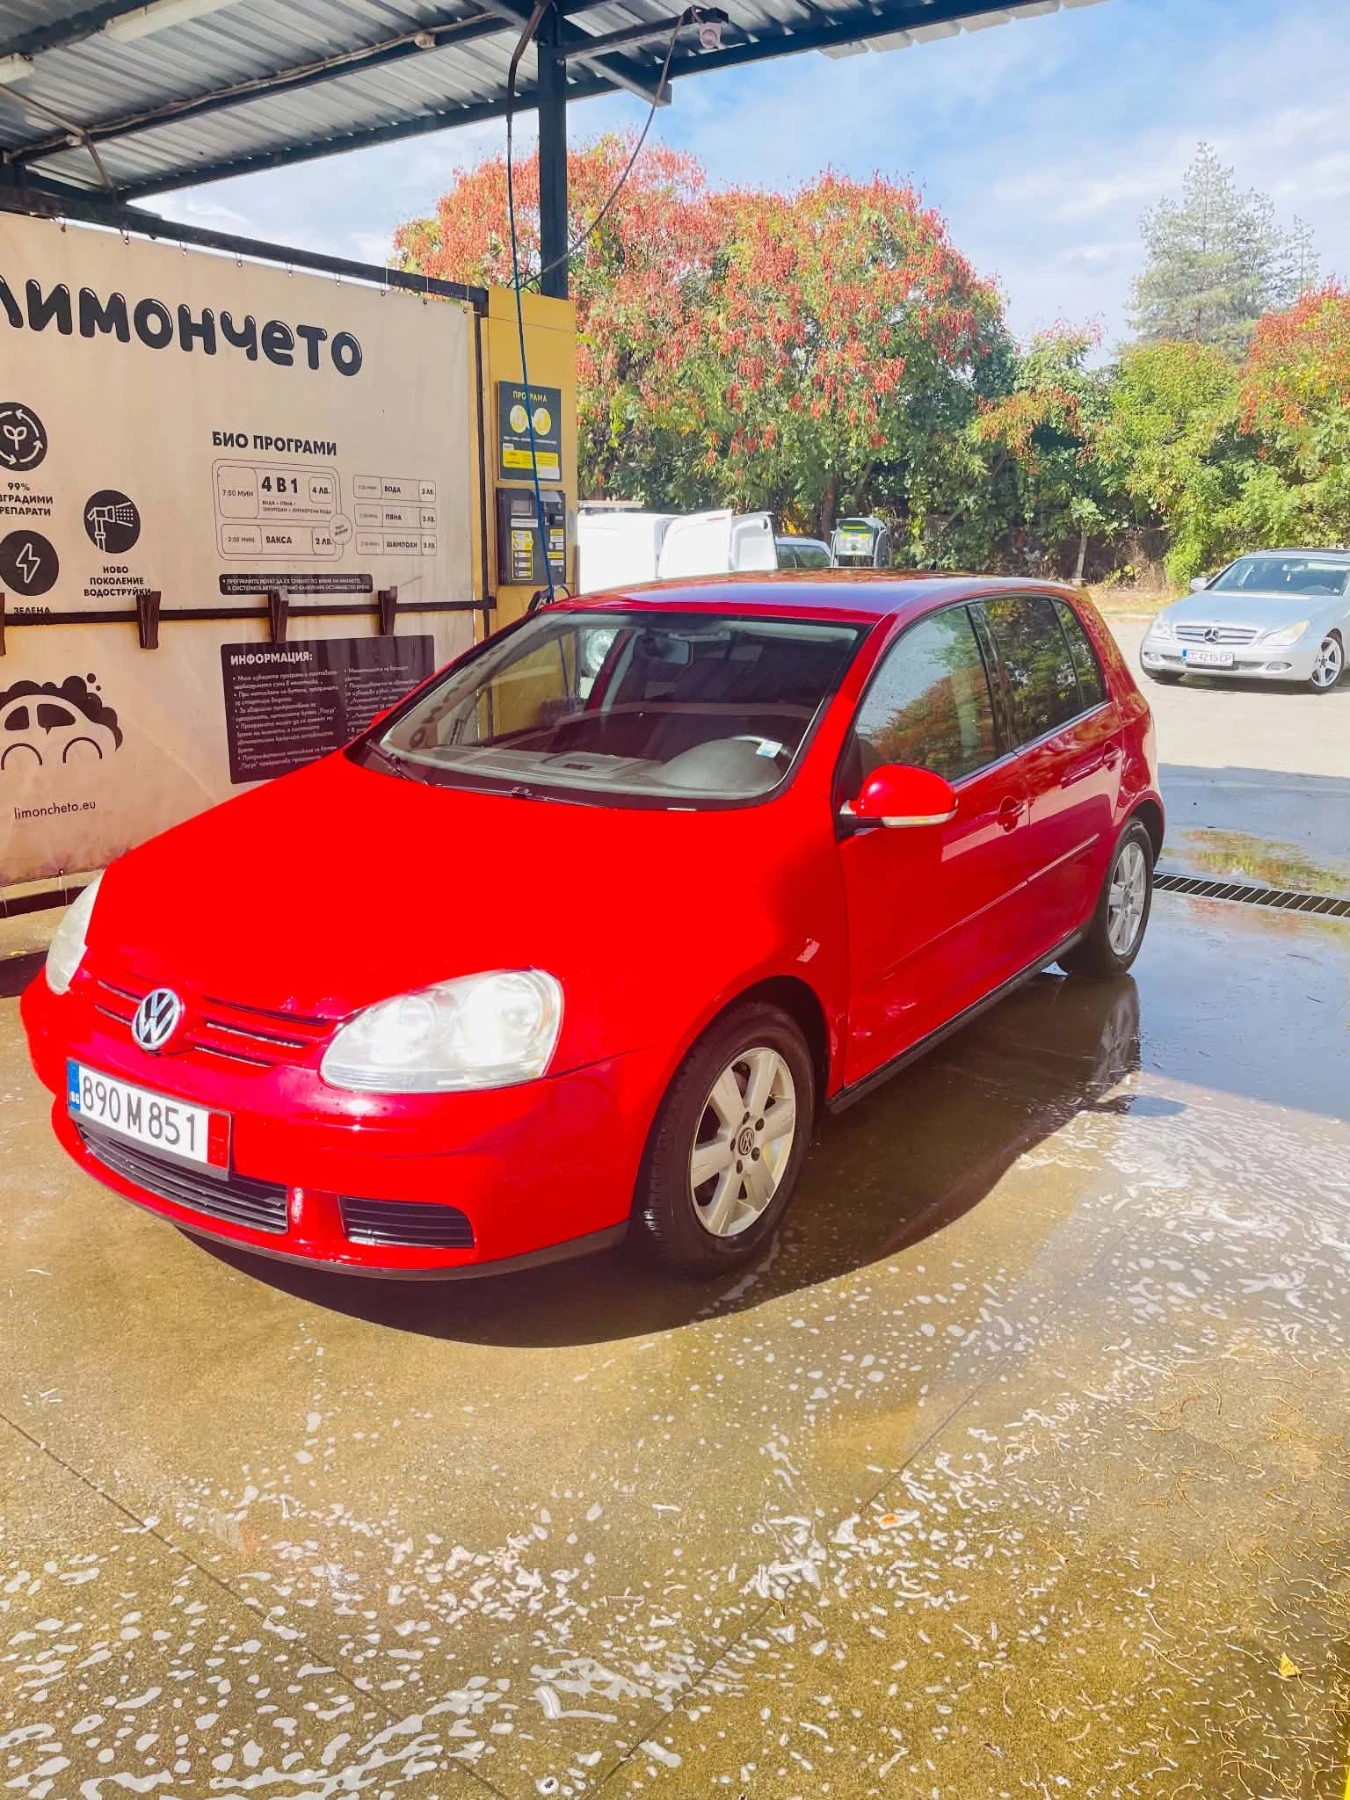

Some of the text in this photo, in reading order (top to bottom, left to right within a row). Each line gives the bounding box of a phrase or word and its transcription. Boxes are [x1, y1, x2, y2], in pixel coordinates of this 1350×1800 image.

[513, 391, 547, 402] ПРОРАМА
[212, 431, 337, 456] БИО ПРОГРАМИ
[8, 482, 30, 491] 99%
[261, 476, 298, 493] 4 В 1
[385, 485, 401, 493] ВОДА
[312, 486, 318, 494] 4
[385, 513, 402, 521] ПЯНА
[266, 535, 292, 544] ВАКСА
[103, 566, 129, 574] НОВО
[89, 577, 144, 585] ПОКОЛЕНИЕ
[84, 586, 151, 598] ВОДОСТРУЙКИ
[230, 652, 313, 666] ИНФОРМАЦИЯ:
[14, 801, 96, 820] limoncheto.eu
[83, 1076, 196, 1152] 890 M 851
